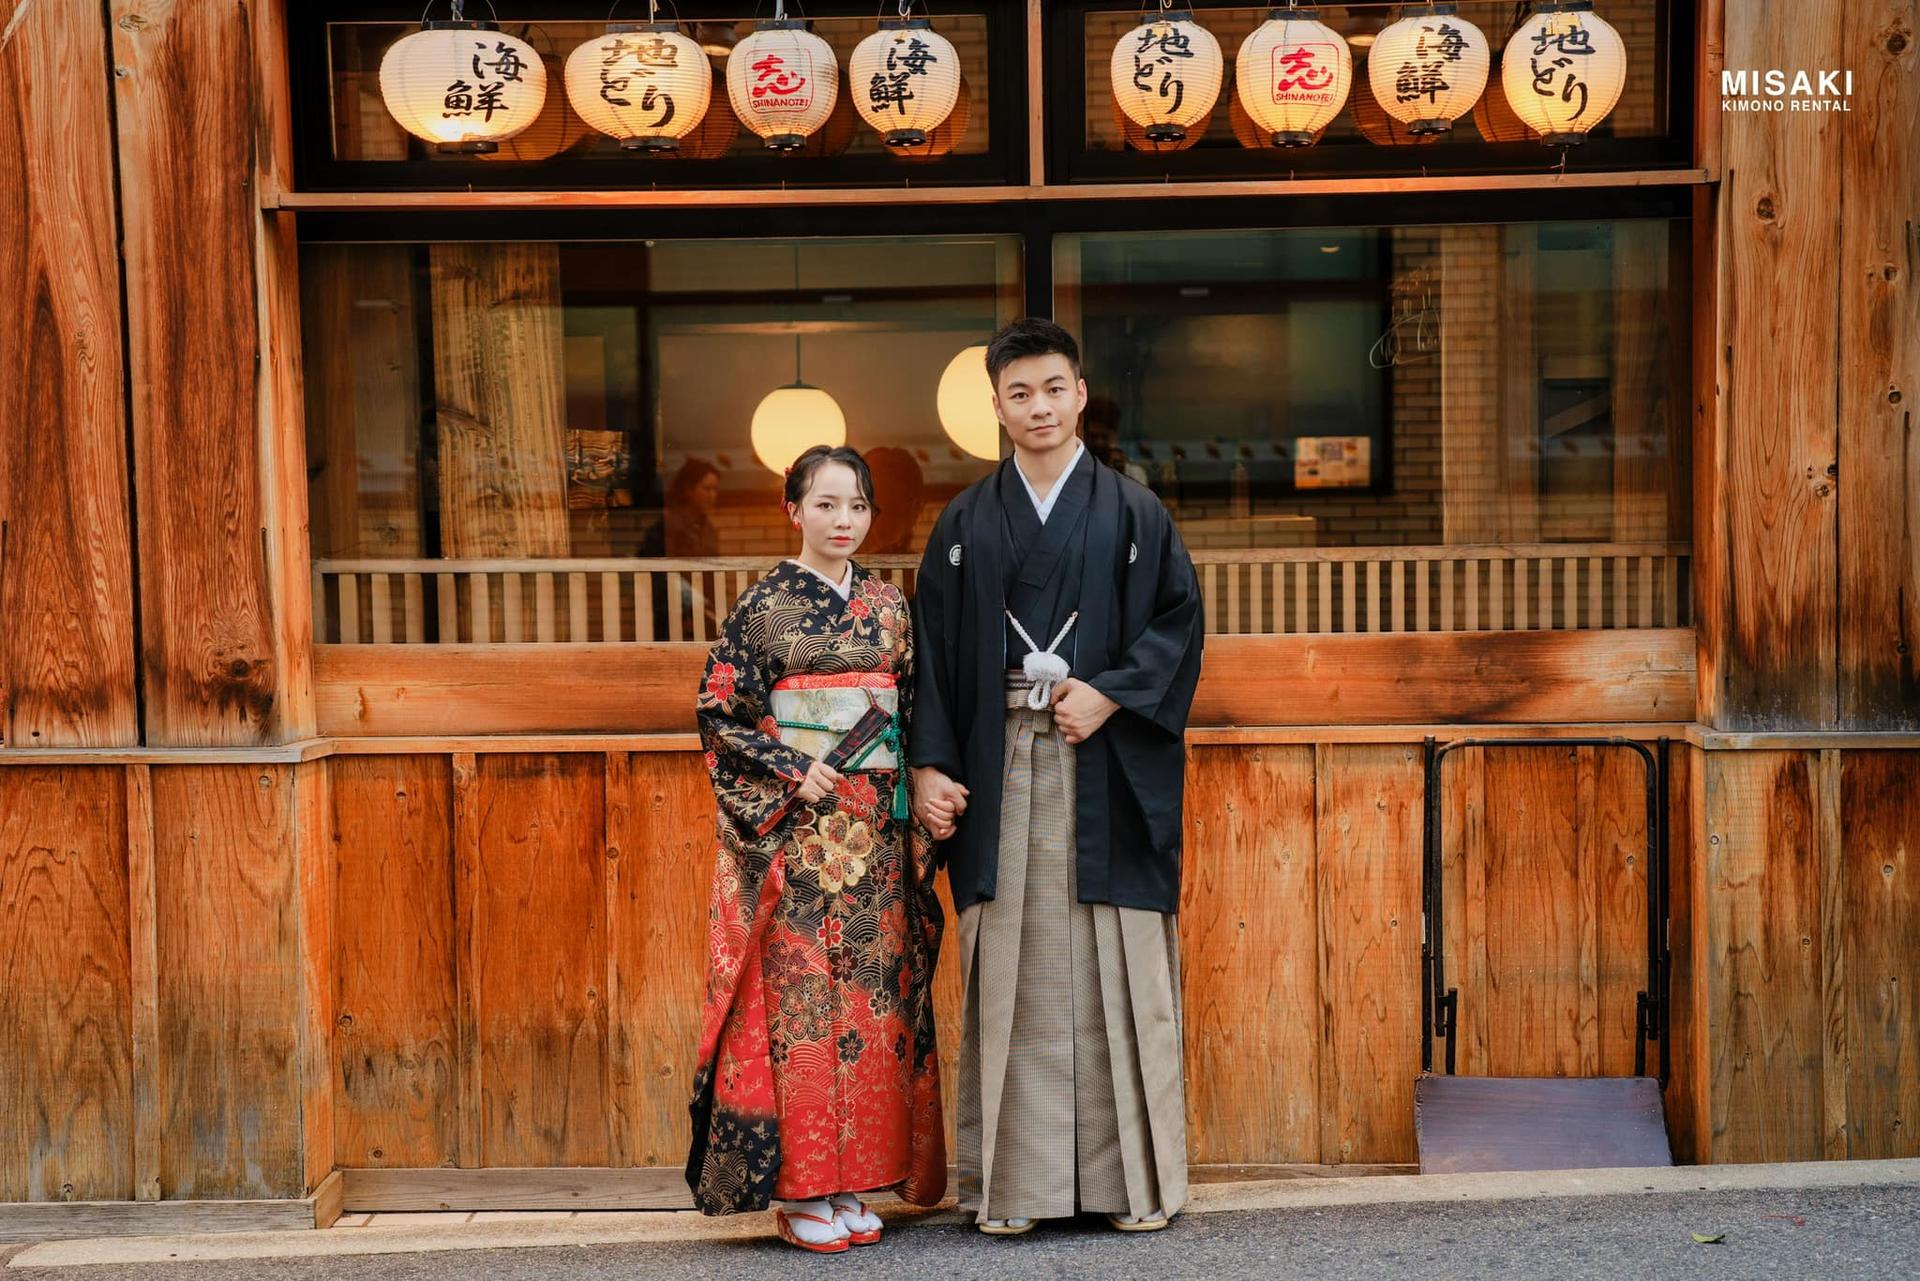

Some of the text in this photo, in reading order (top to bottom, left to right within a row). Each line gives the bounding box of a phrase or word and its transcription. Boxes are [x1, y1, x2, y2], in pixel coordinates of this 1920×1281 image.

[442, 41, 529, 122] 海鮮
[600, 38, 679, 127] 地どり
[869, 37, 938, 115] 海鮮
[1133, 27, 1195, 114] 地どり
[1395, 23, 1470, 104] 海鮮
[1529, 24, 1596, 121] 地どり
